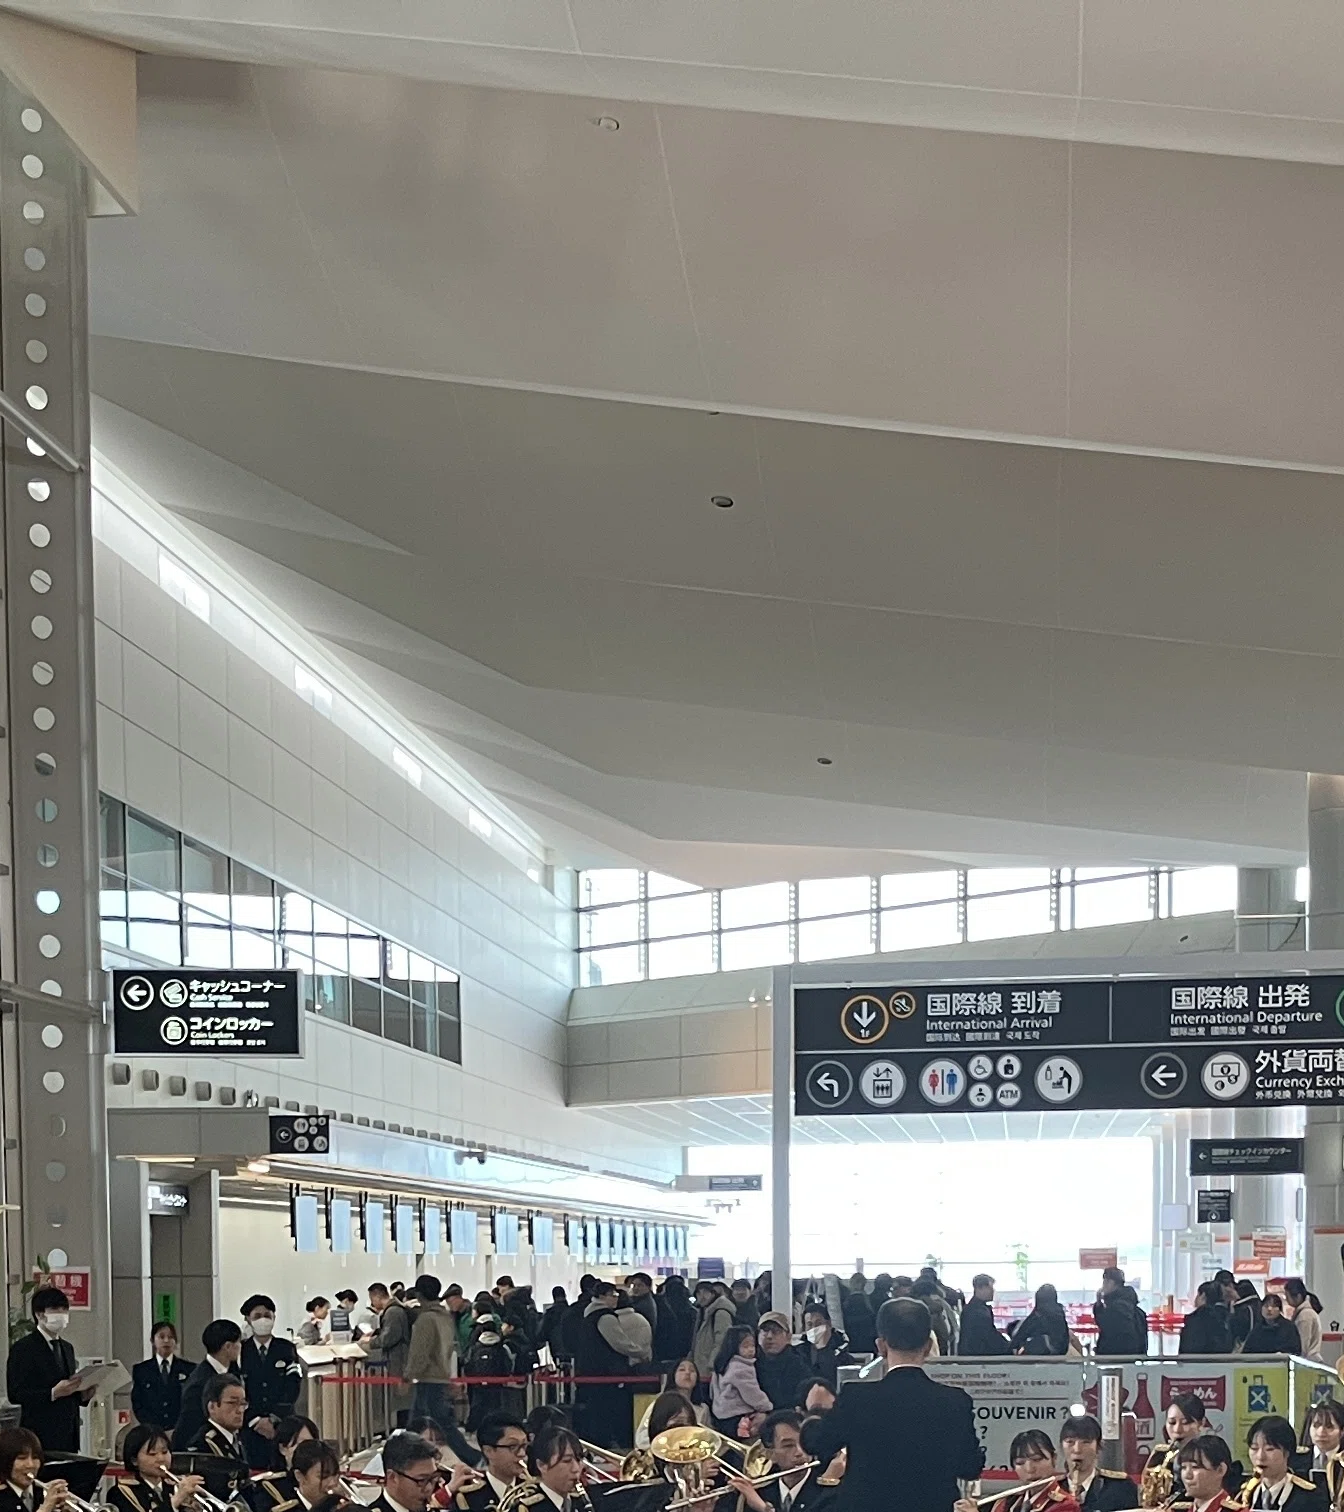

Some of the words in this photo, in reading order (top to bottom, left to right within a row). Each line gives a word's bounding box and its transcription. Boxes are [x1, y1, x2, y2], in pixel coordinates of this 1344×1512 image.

[189, 979, 286, 993] キャッシュコーナー
[926, 991, 1003, 1017] 国際線
[1010, 989, 1062, 1015] 到着
[1171, 985, 1249, 1011] 国際線
[1258, 983, 1310, 1008] 出発
[189, 1016, 274, 1031] コインロッカー
[926, 1017, 1007, 1031] International
[1010, 1015, 1053, 1030] Arrival
[1170, 1010, 1254, 1025] International
[1257, 1010, 1323, 1025] Departure
[1255, 1076, 1313, 1090] Currency
[999, 1089, 1019, 1099] ATM
